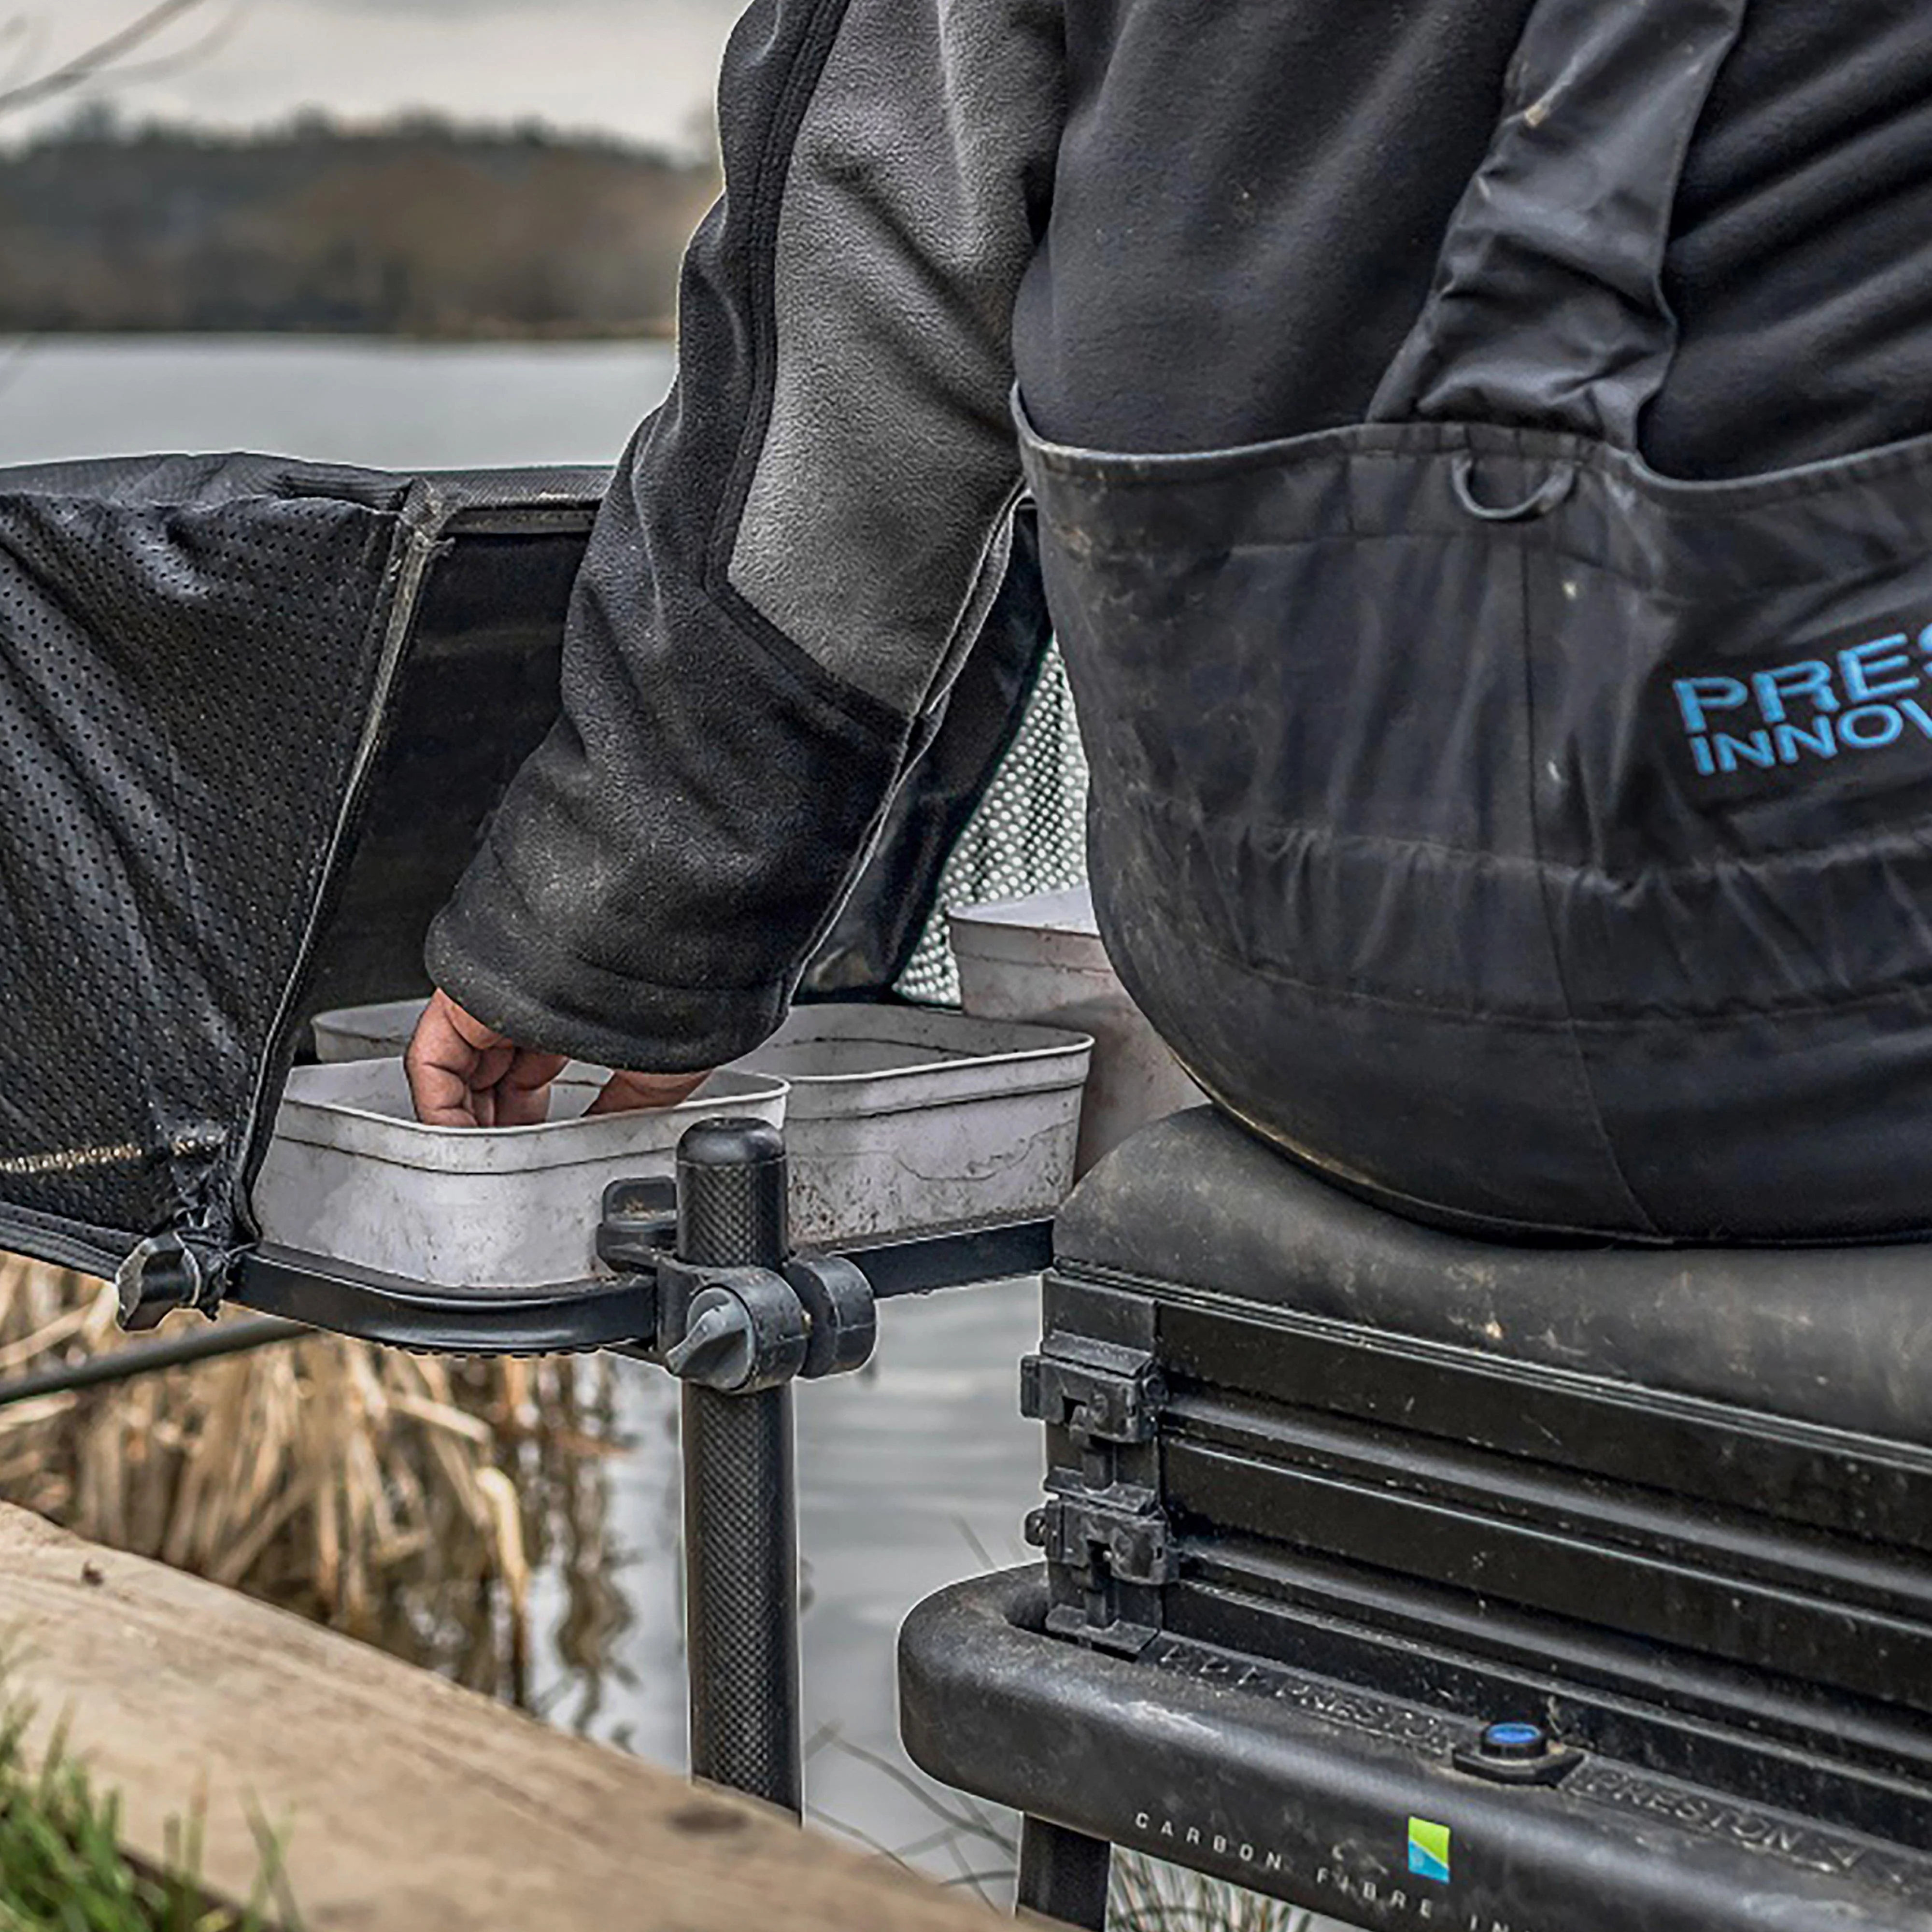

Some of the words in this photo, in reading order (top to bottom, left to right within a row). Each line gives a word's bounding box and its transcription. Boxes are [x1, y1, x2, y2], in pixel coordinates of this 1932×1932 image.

[1672, 623, 1932, 733] PRE
[1135, 1812, 1281, 1870] CARBON
[1469, 1913, 1530, 1932] IN
